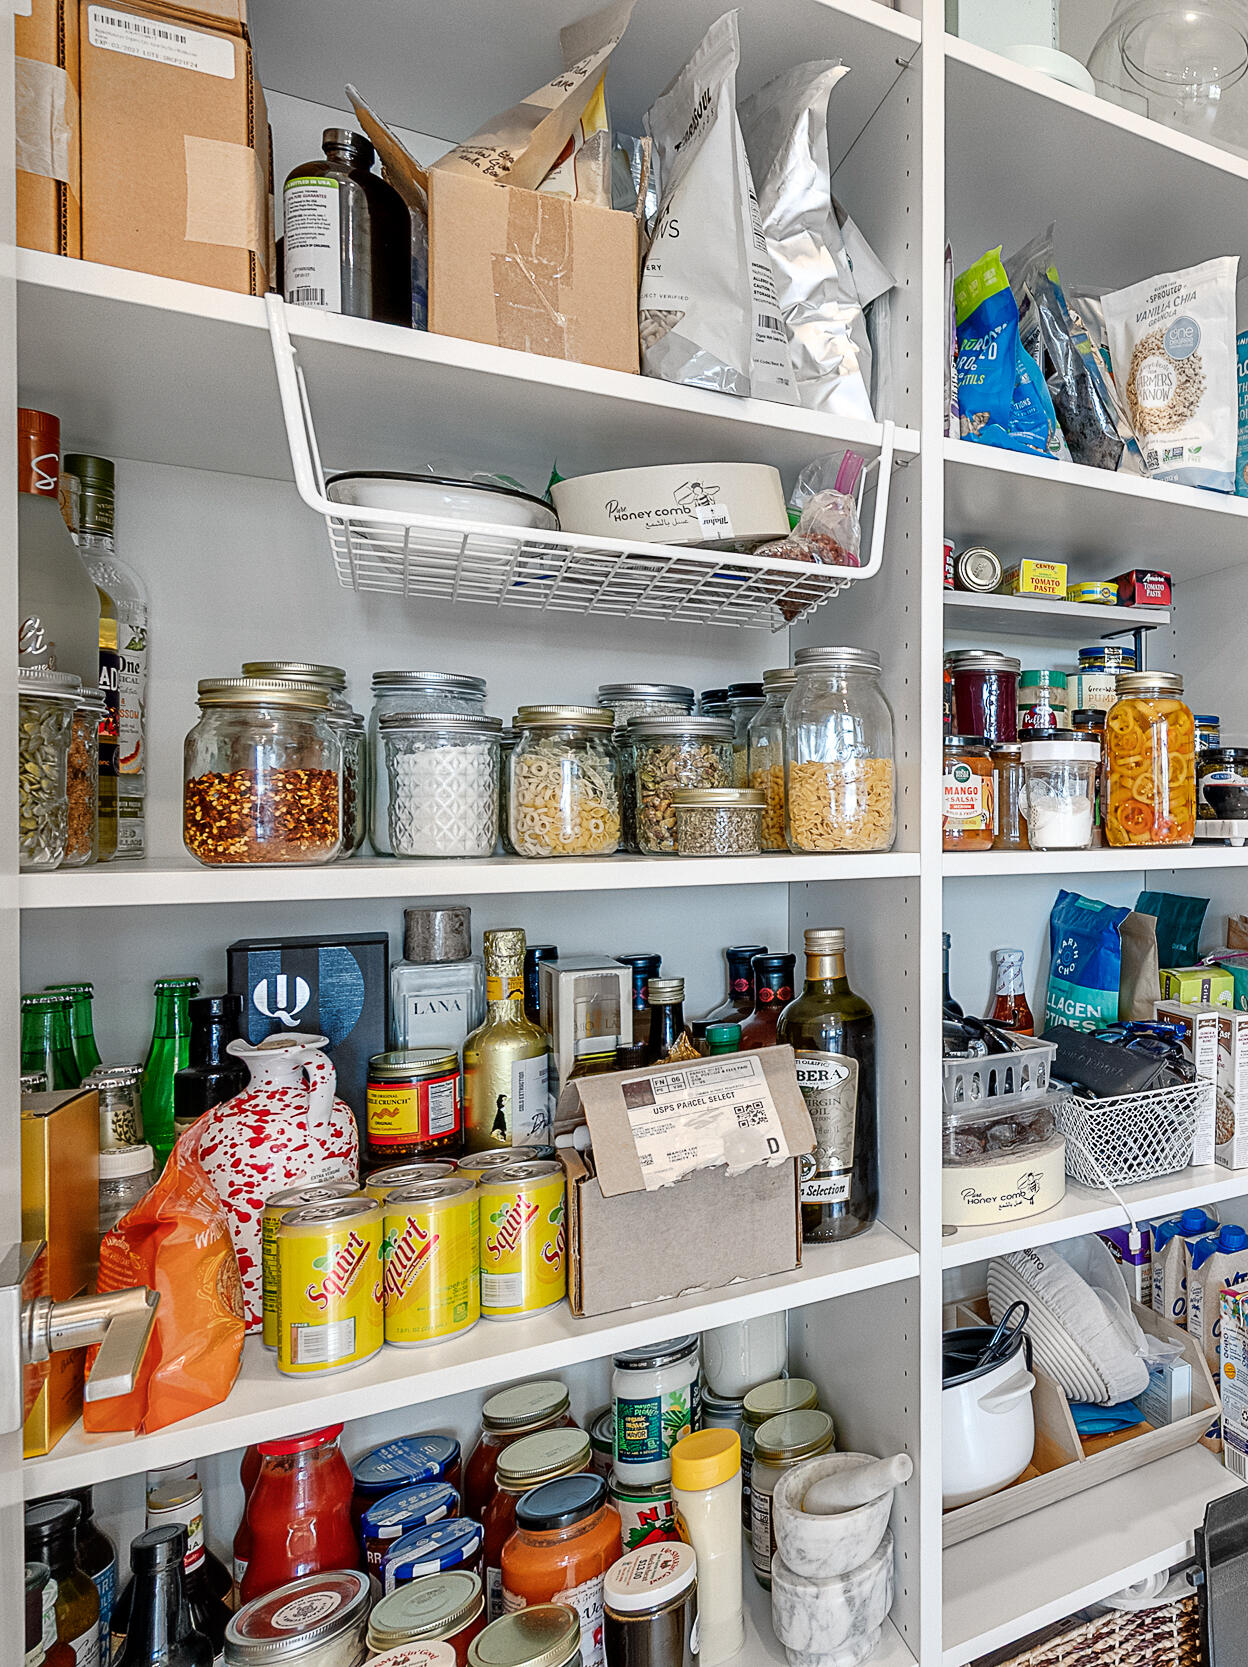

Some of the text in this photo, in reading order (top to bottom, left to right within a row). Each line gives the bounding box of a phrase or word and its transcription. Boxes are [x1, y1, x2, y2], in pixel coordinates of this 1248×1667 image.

[1150, 284, 1182, 304] SPROUTED
[1136, 290, 1197, 323] VANILLA CHIA
[1030, 577, 1060, 587] TOMATO
[1033, 585, 1056, 594] PASTE
[944, 786, 978, 795] MANGO
[414, 998, 463, 1015] LANA
[653, 1091, 736, 1115] USPS PARCEL SELECT
[767, 1137, 780, 1155] D
[806, 1184, 846, 1197] Selection
[486, 1194, 532, 1261] Squirt
[308, 1230, 364, 1310] Squirt
[374, 1215, 428, 1306] Squirt
